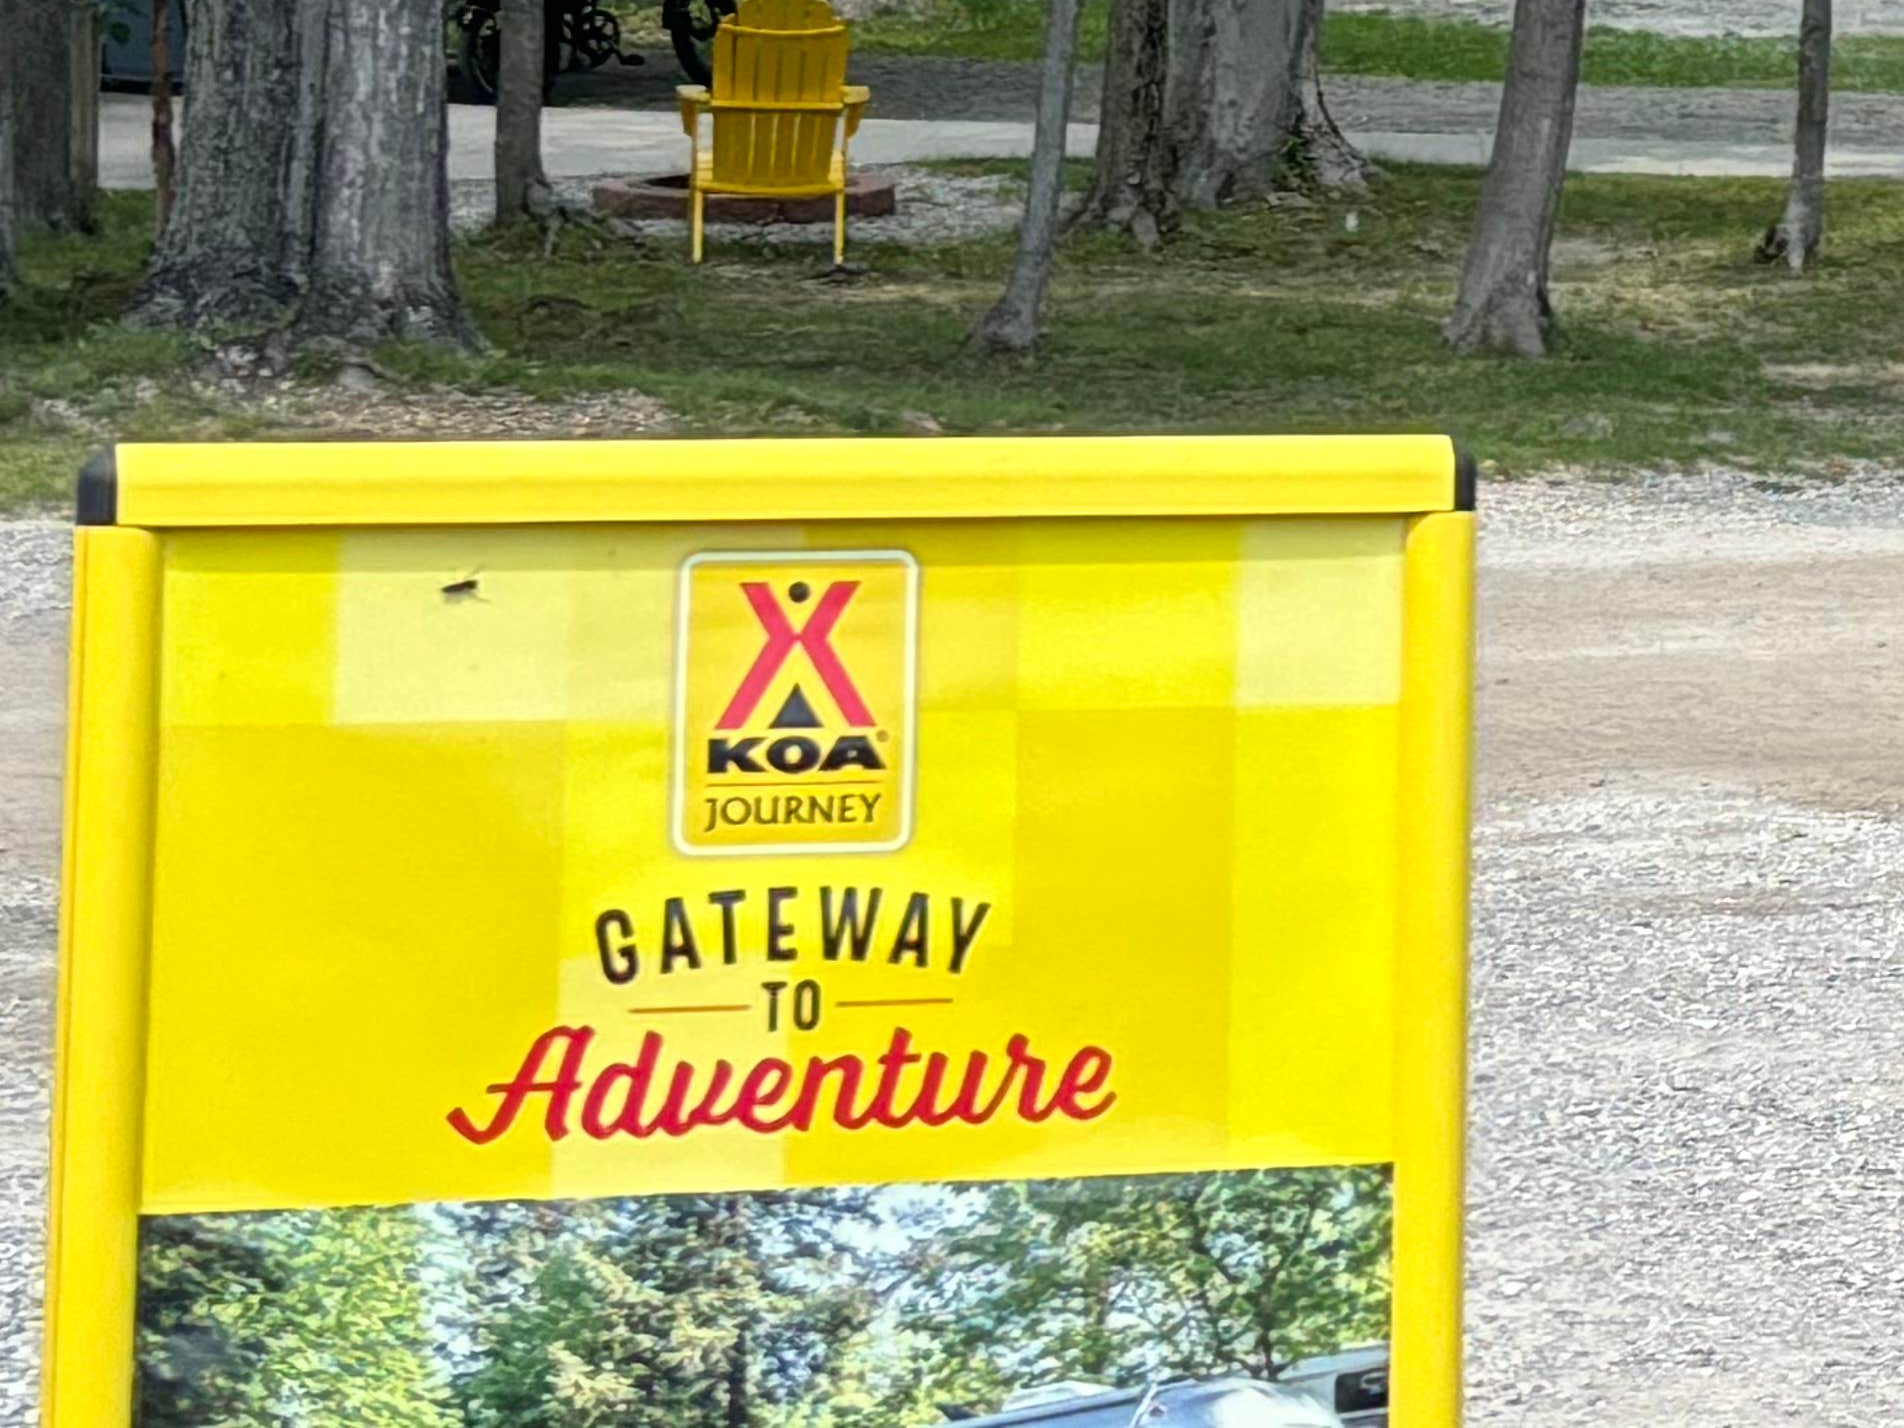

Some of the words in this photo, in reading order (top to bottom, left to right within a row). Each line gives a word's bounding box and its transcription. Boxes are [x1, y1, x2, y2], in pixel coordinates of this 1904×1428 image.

[708, 735, 887, 774] KOA
[704, 793, 882, 833] JOURNEY
[595, 885, 991, 985] GATEWAY
[762, 979, 822, 1032] TO
[445, 1024, 1117, 1146] Adventure
